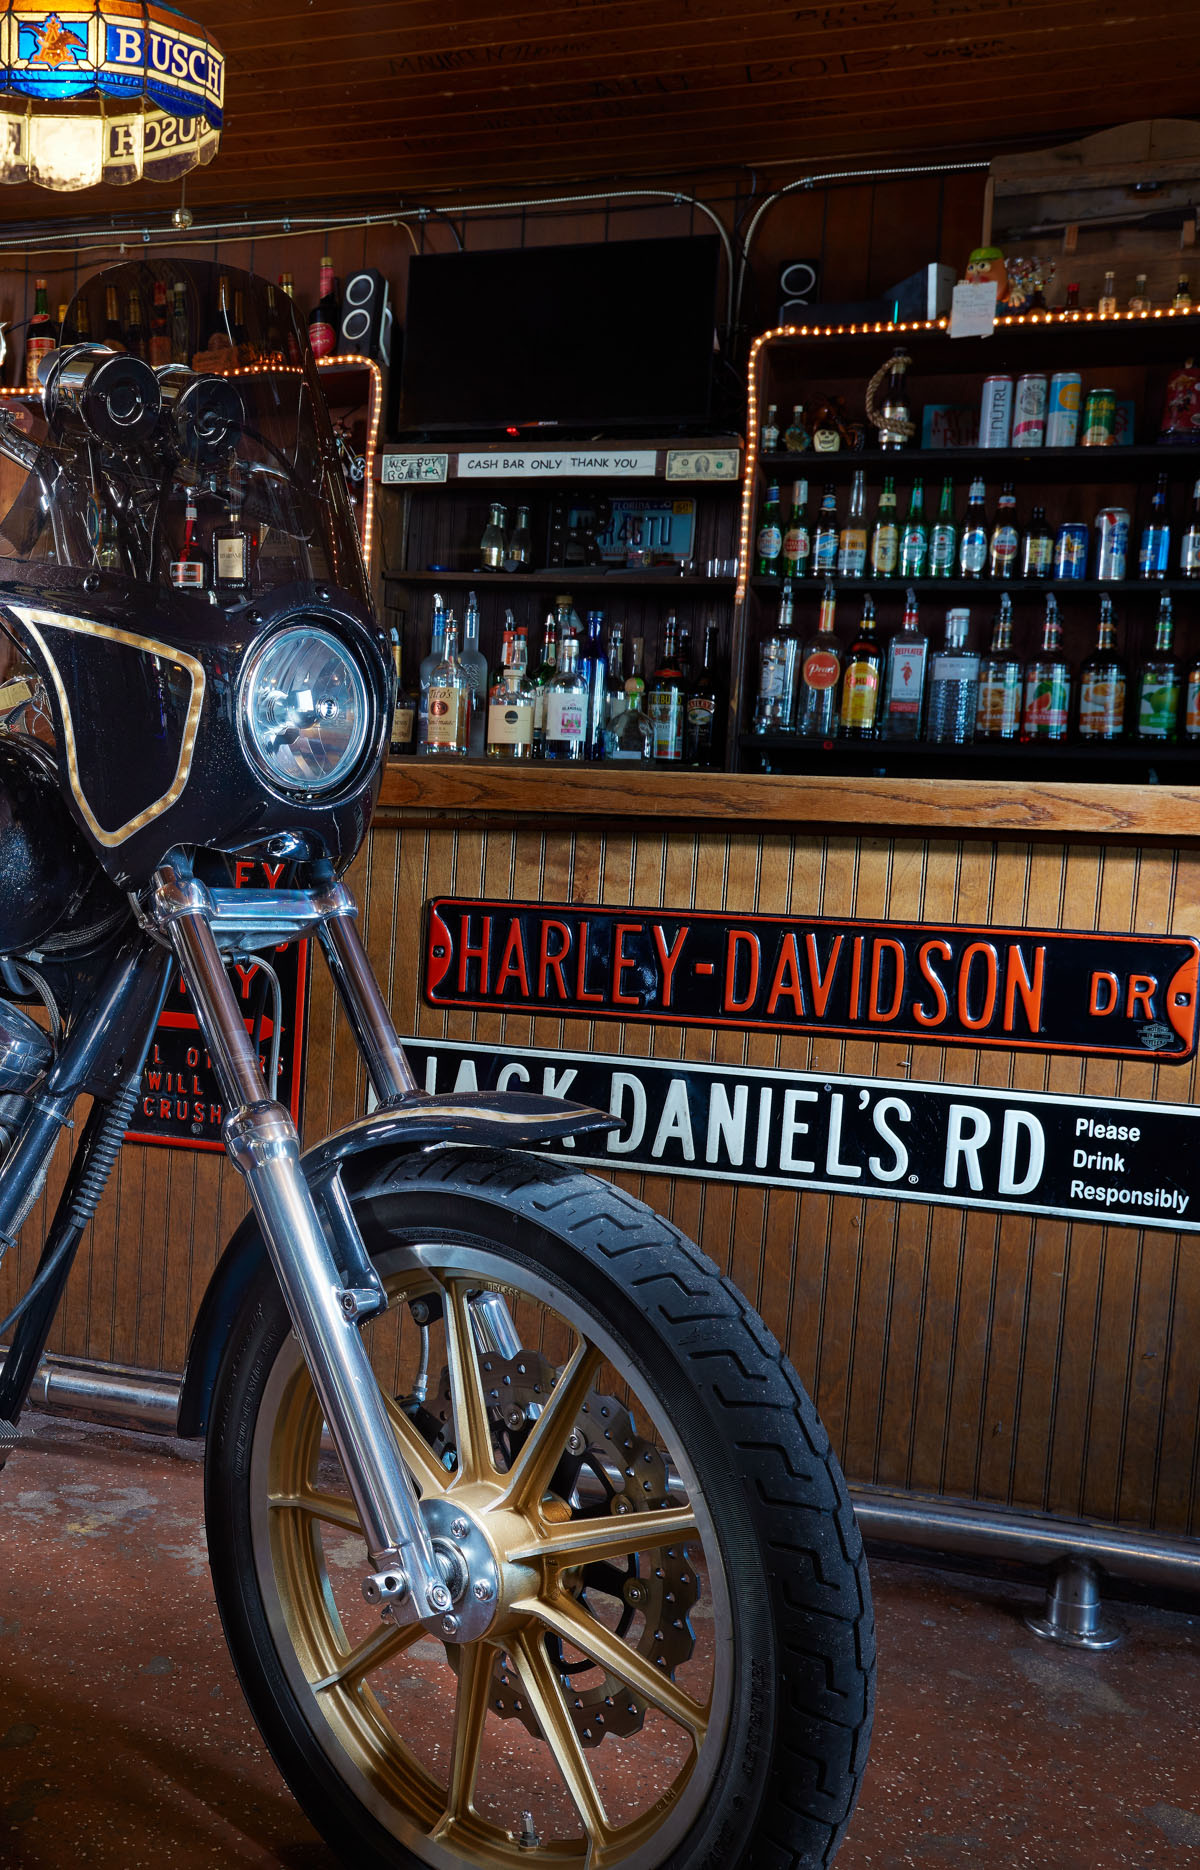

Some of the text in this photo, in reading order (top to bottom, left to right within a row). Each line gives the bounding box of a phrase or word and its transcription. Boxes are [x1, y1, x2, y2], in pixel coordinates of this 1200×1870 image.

[116, 28, 220, 97] BUSCH
[467, 457, 638, 470] CASH BAR ONLY THANK YOU
[651, 694, 682, 705] TRIBUO
[456, 913, 1159, 1034] HARLEY-DAVIDSON DR
[148, 1071, 205, 1096] WILL
[607, 1072, 914, 1183] DANIEL'S
[945, 1102, 1046, 1197] RD
[1075, 1117, 1141, 1142] Please
[1072, 1149, 1126, 1173] Drink
[1070, 1179, 1190, 1215] Responsibly
